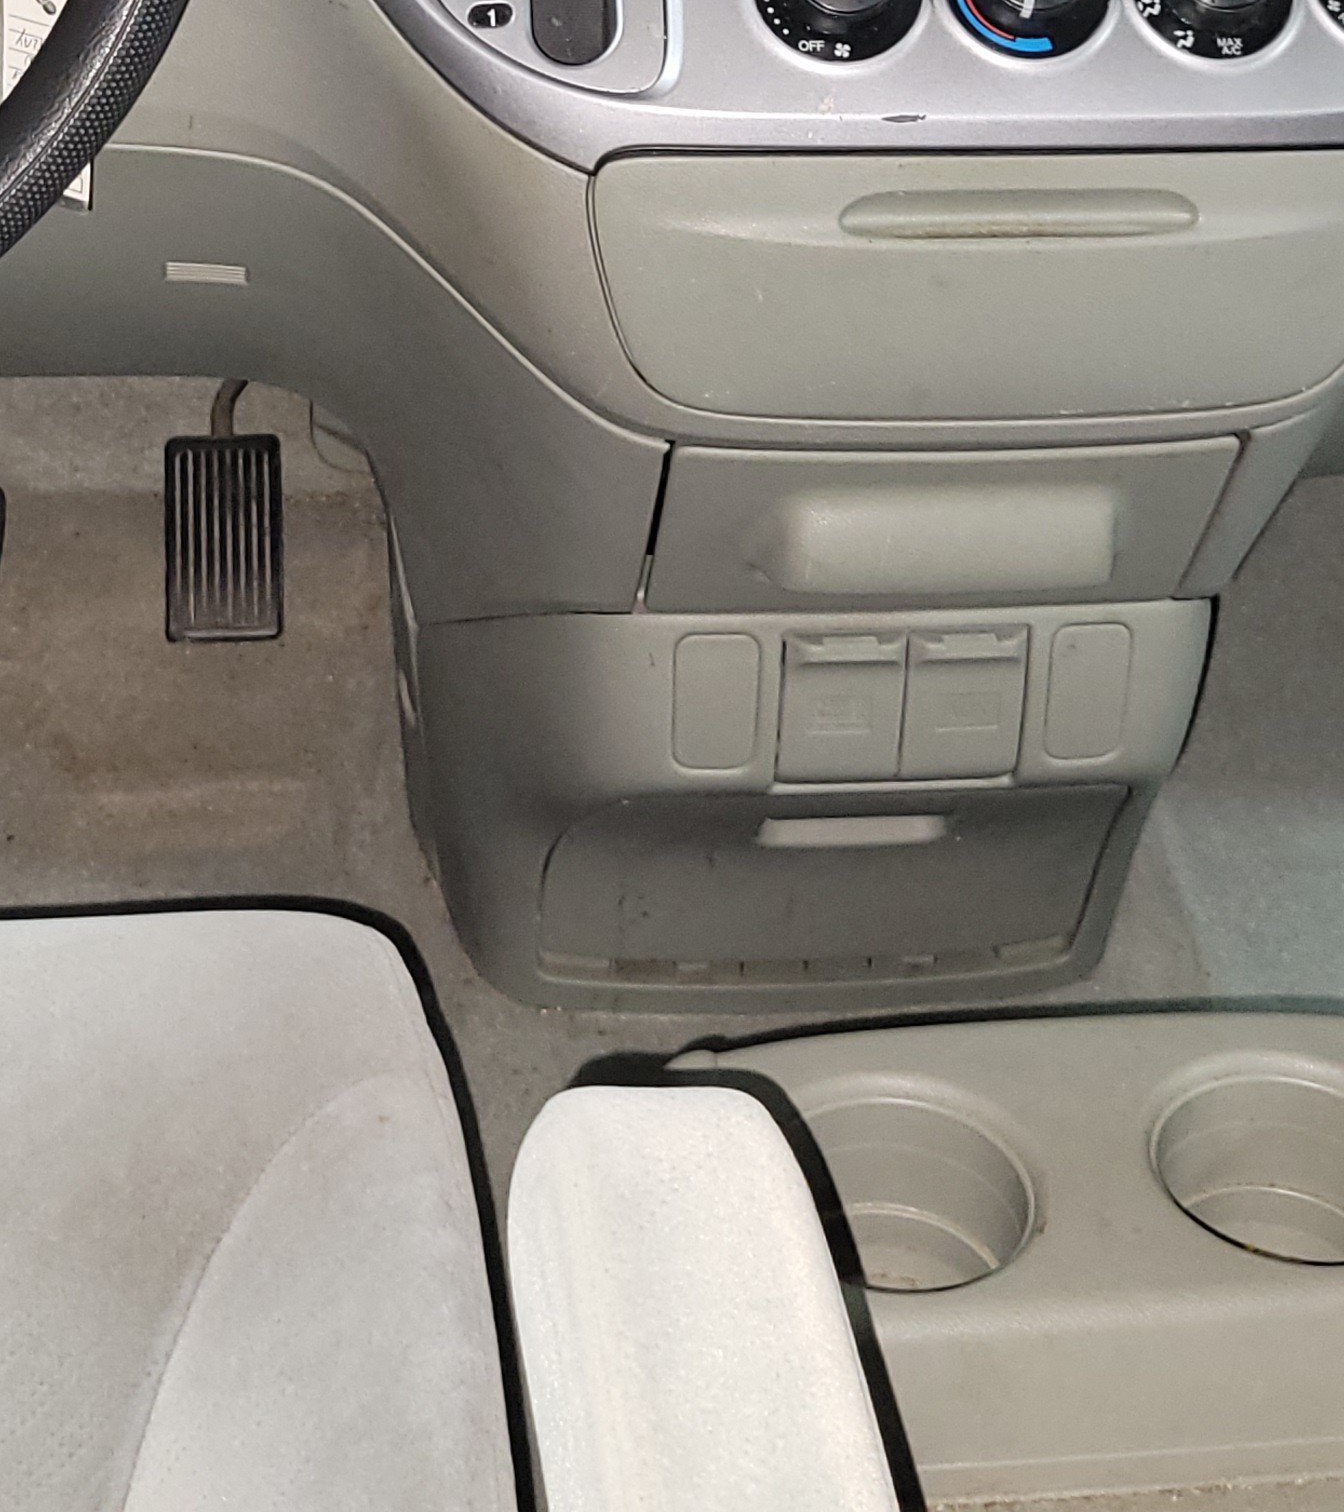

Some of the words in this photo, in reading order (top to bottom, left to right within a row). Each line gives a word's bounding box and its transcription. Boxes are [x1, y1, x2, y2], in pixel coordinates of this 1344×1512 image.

[488, 9, 495, 26] 1
[798, 40, 824, 51] OFF
[1216, 37, 1243, 47] MAX
[1222, 46, 1242, 55] A/C
